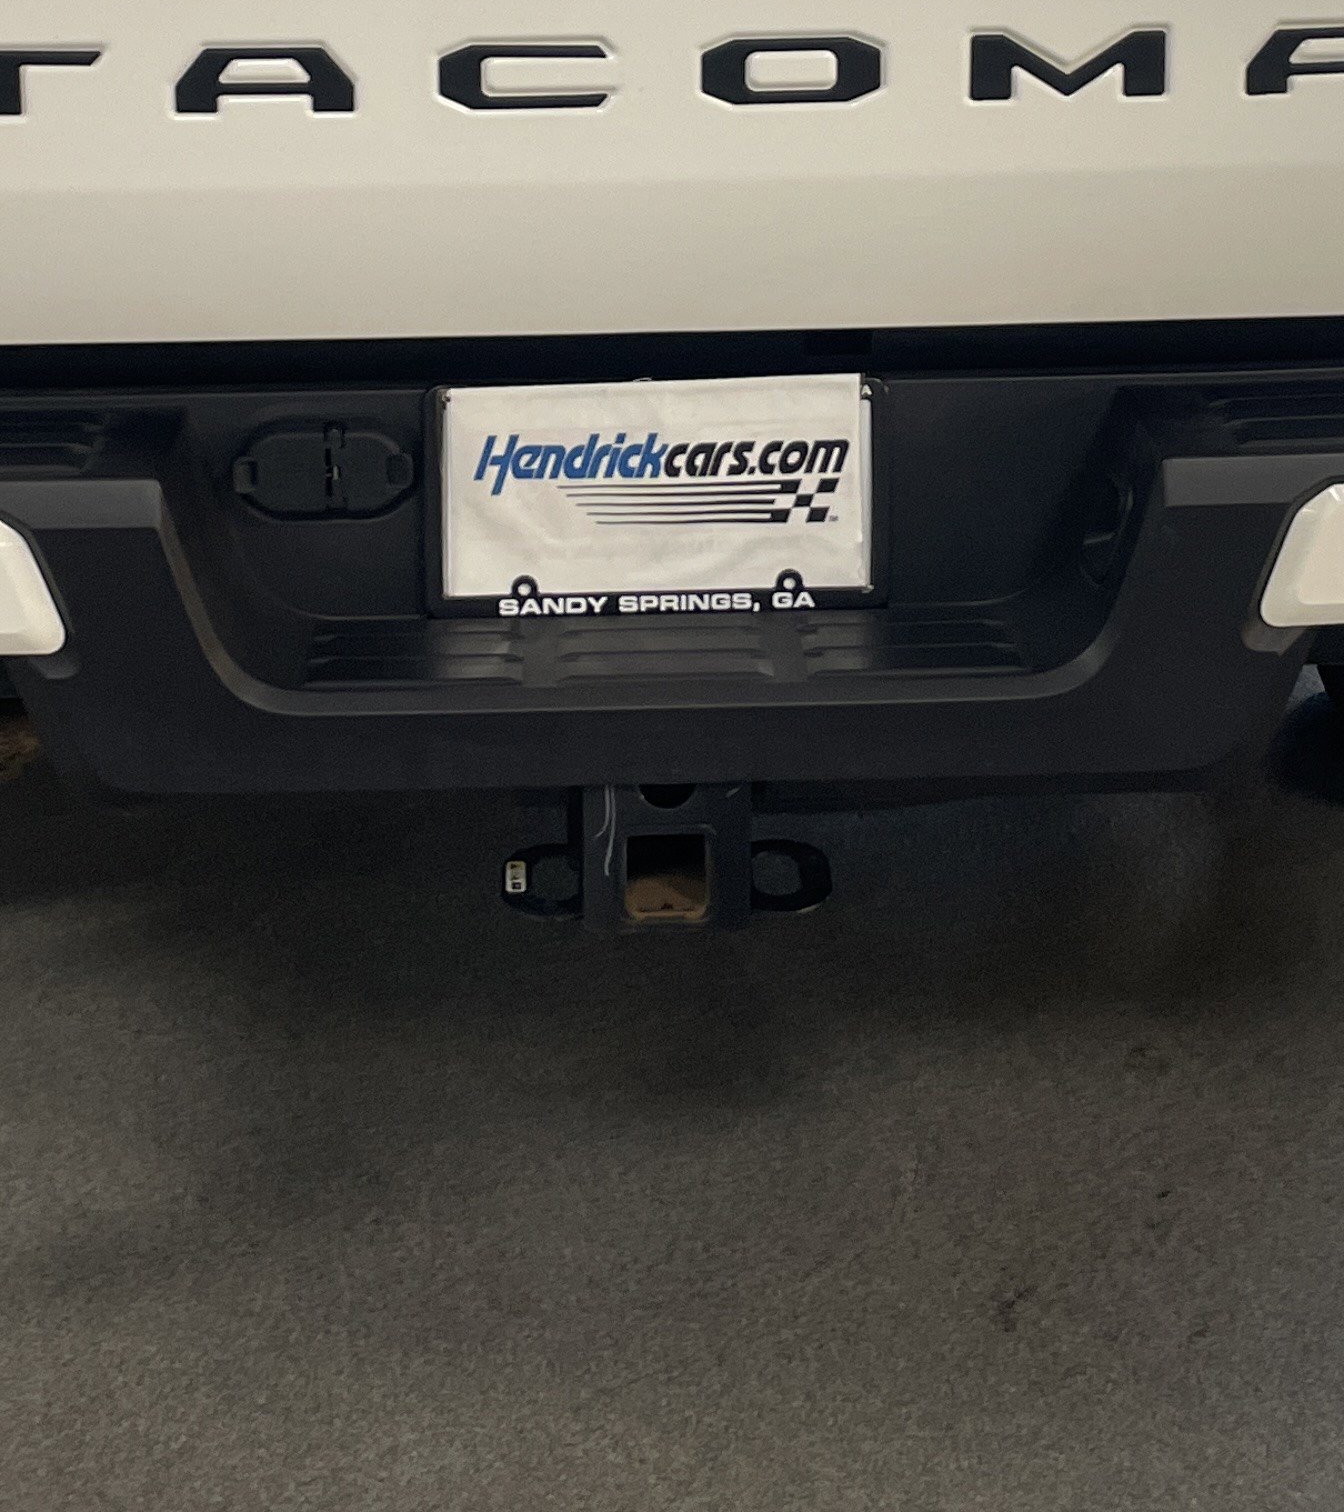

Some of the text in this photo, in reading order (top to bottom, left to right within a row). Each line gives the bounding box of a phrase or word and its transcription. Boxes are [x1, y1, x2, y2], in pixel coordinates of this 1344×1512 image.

[473, 432, 851, 497] Hendrickcars.com
[498, 591, 816, 617] SANDY SPRINGS, GA
